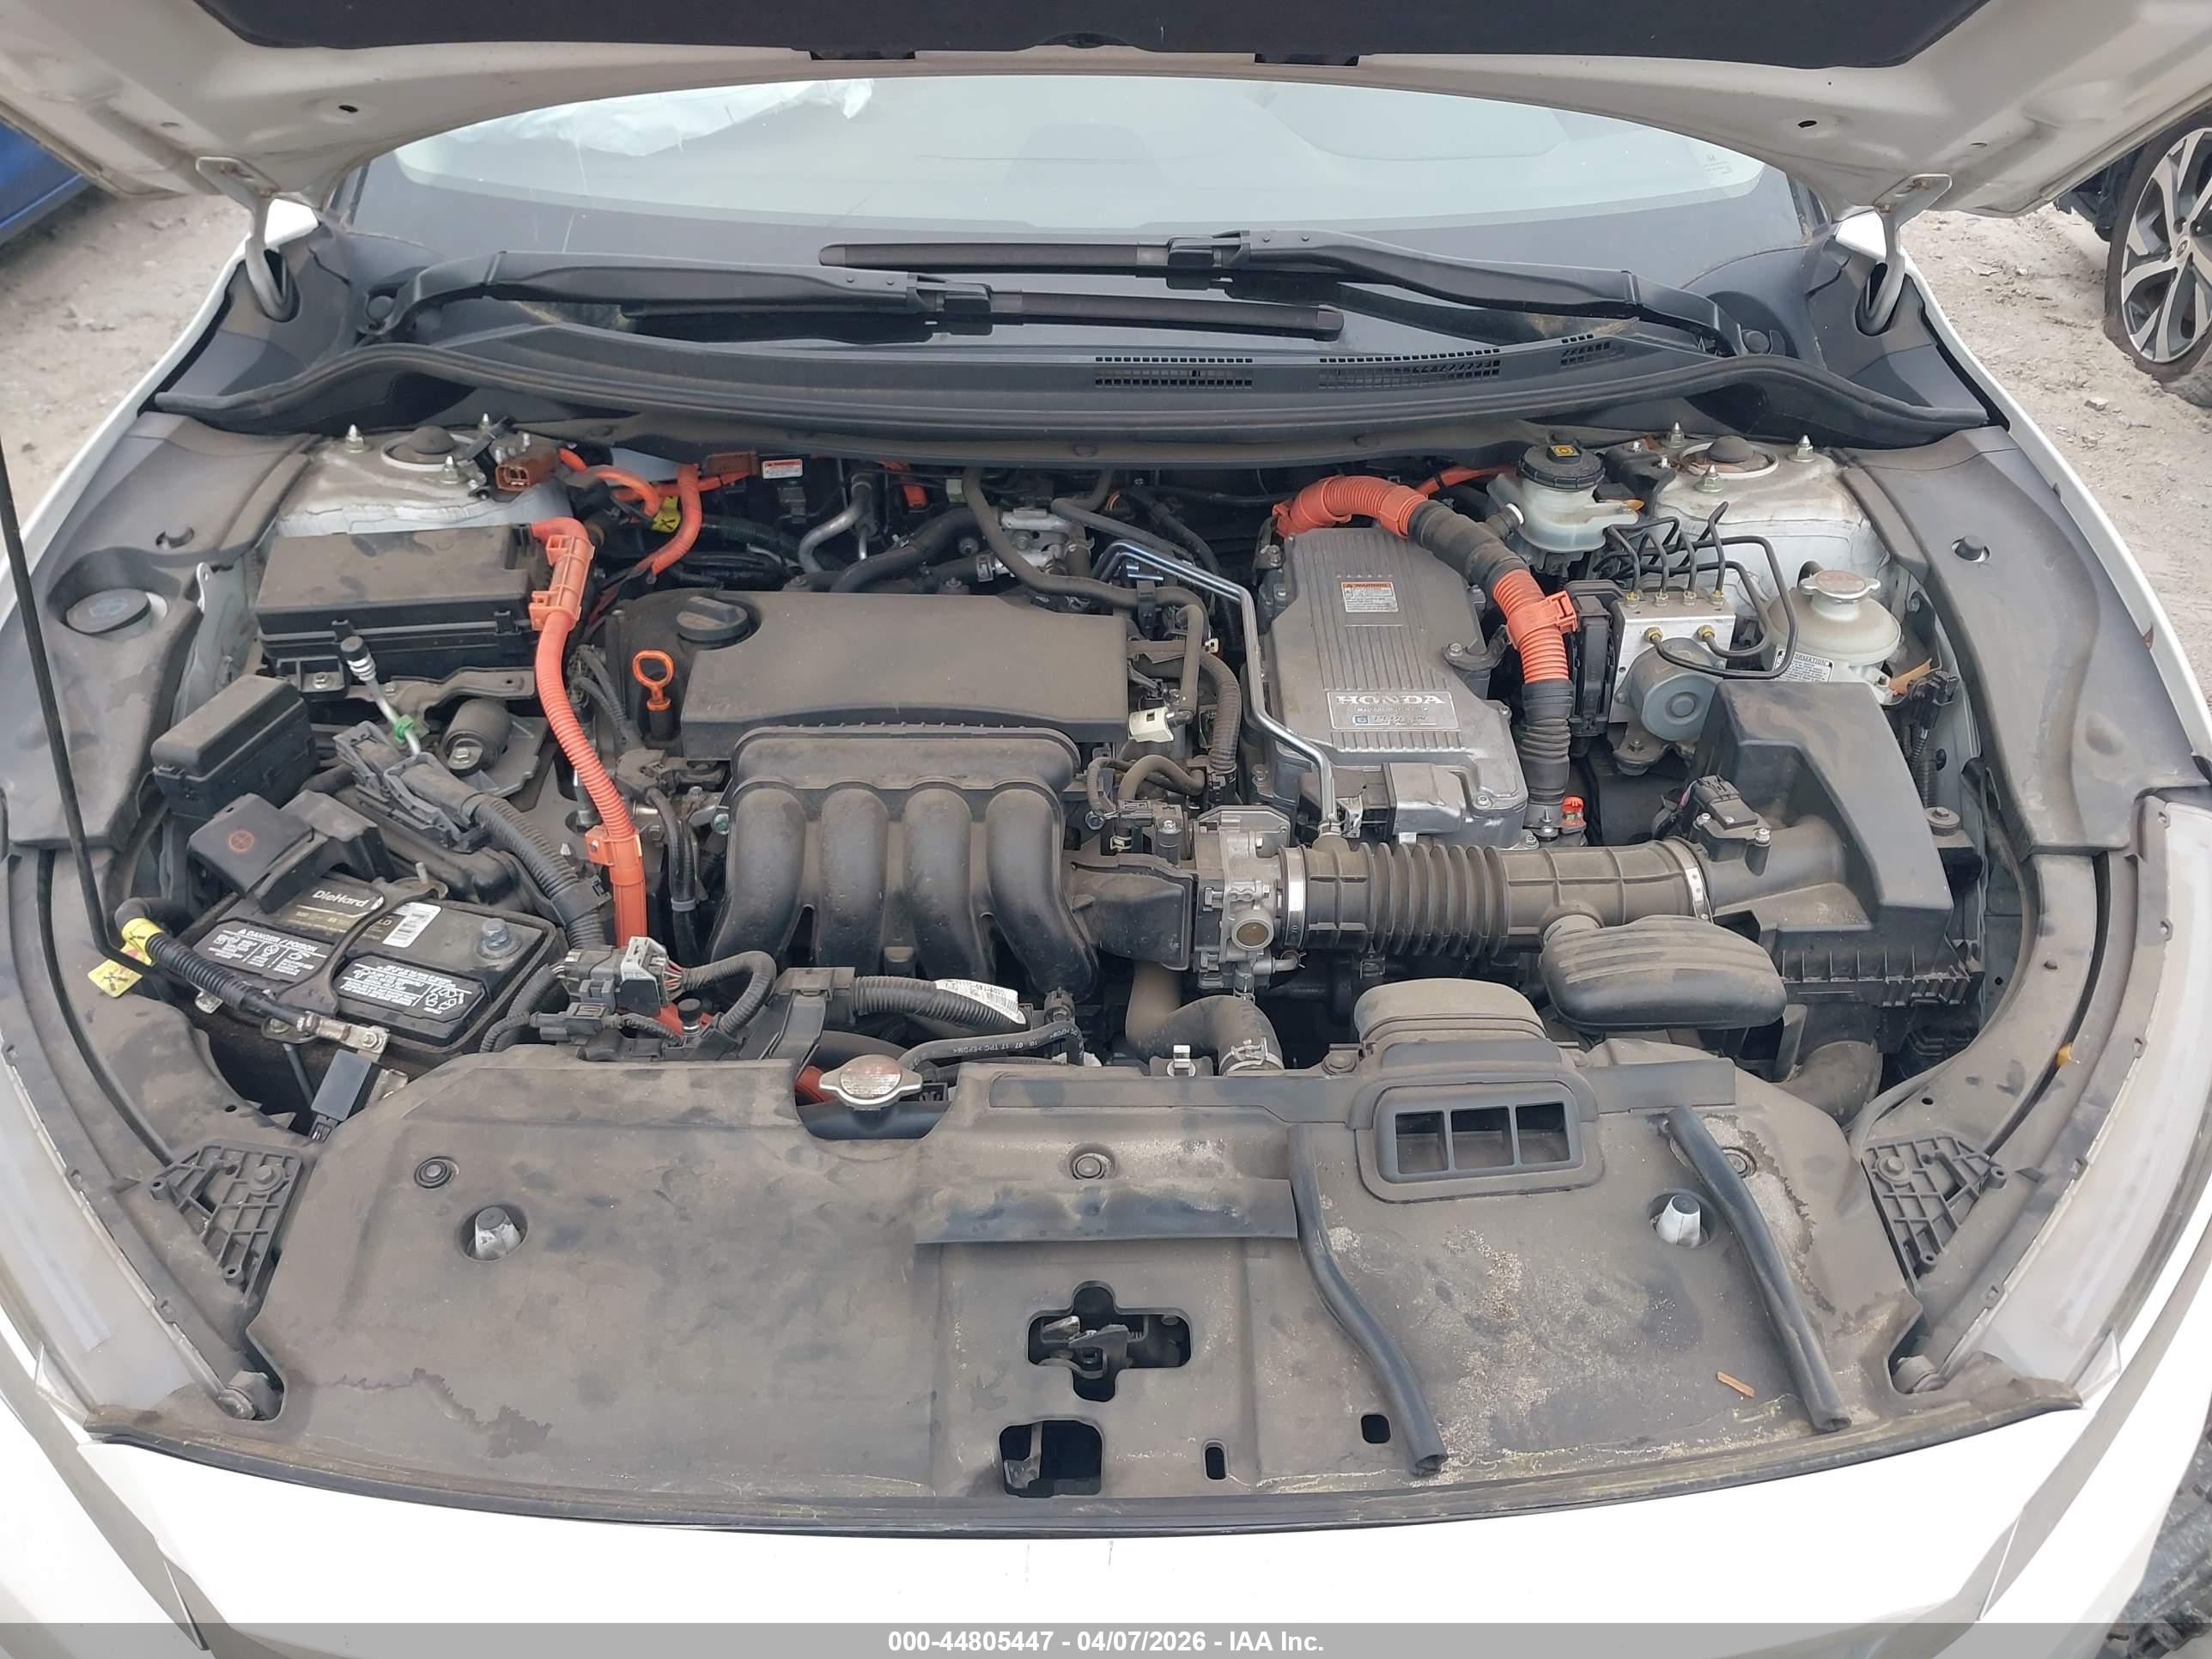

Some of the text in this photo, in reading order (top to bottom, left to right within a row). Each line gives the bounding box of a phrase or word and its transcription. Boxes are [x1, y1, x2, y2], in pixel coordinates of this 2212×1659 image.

[1335, 695, 1446, 705] HONDA
[312, 890, 369, 908] DieHard
[246, 930, 282, 943] DANGER
[285, 940, 319, 952] POISON
